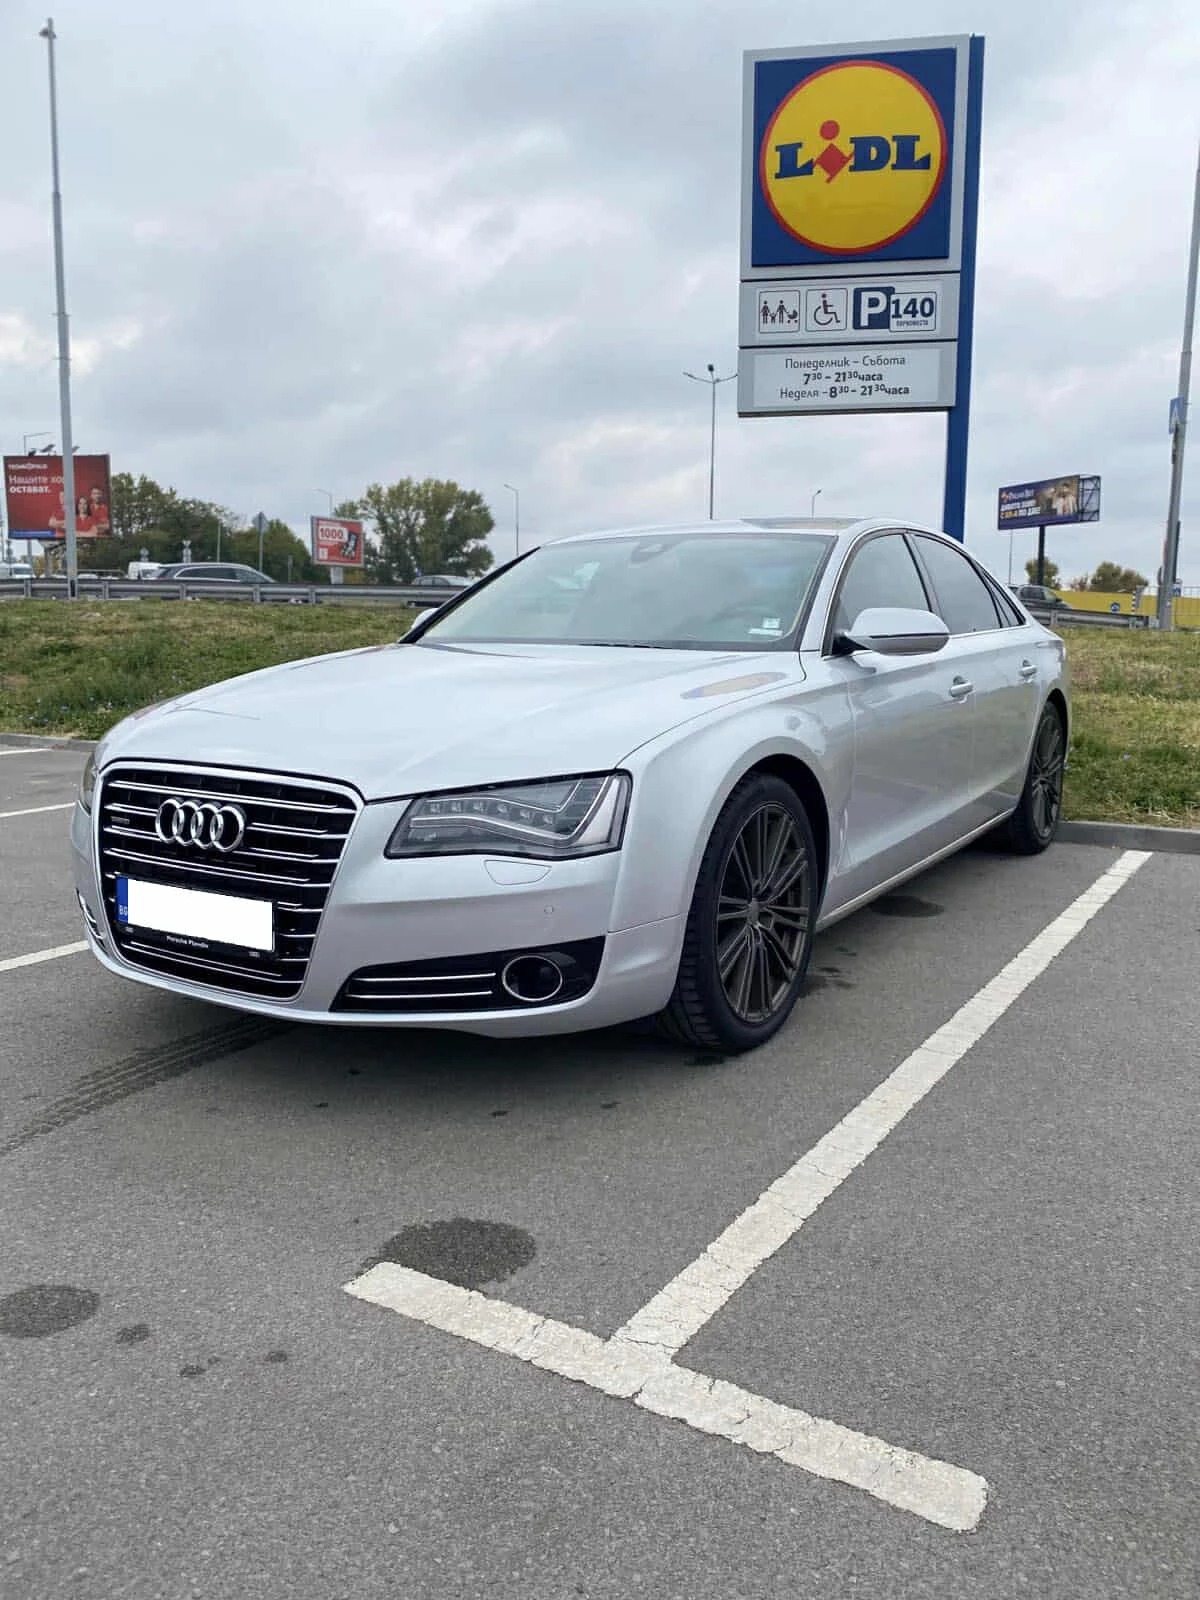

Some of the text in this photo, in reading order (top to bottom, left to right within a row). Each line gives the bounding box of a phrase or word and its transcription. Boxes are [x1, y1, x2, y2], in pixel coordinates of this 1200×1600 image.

[891, 297, 935, 319] 140
[785, 356, 850, 371] Понеделник
[862, 355, 906, 367] Събота
[780, 388, 819, 402] Неделя
